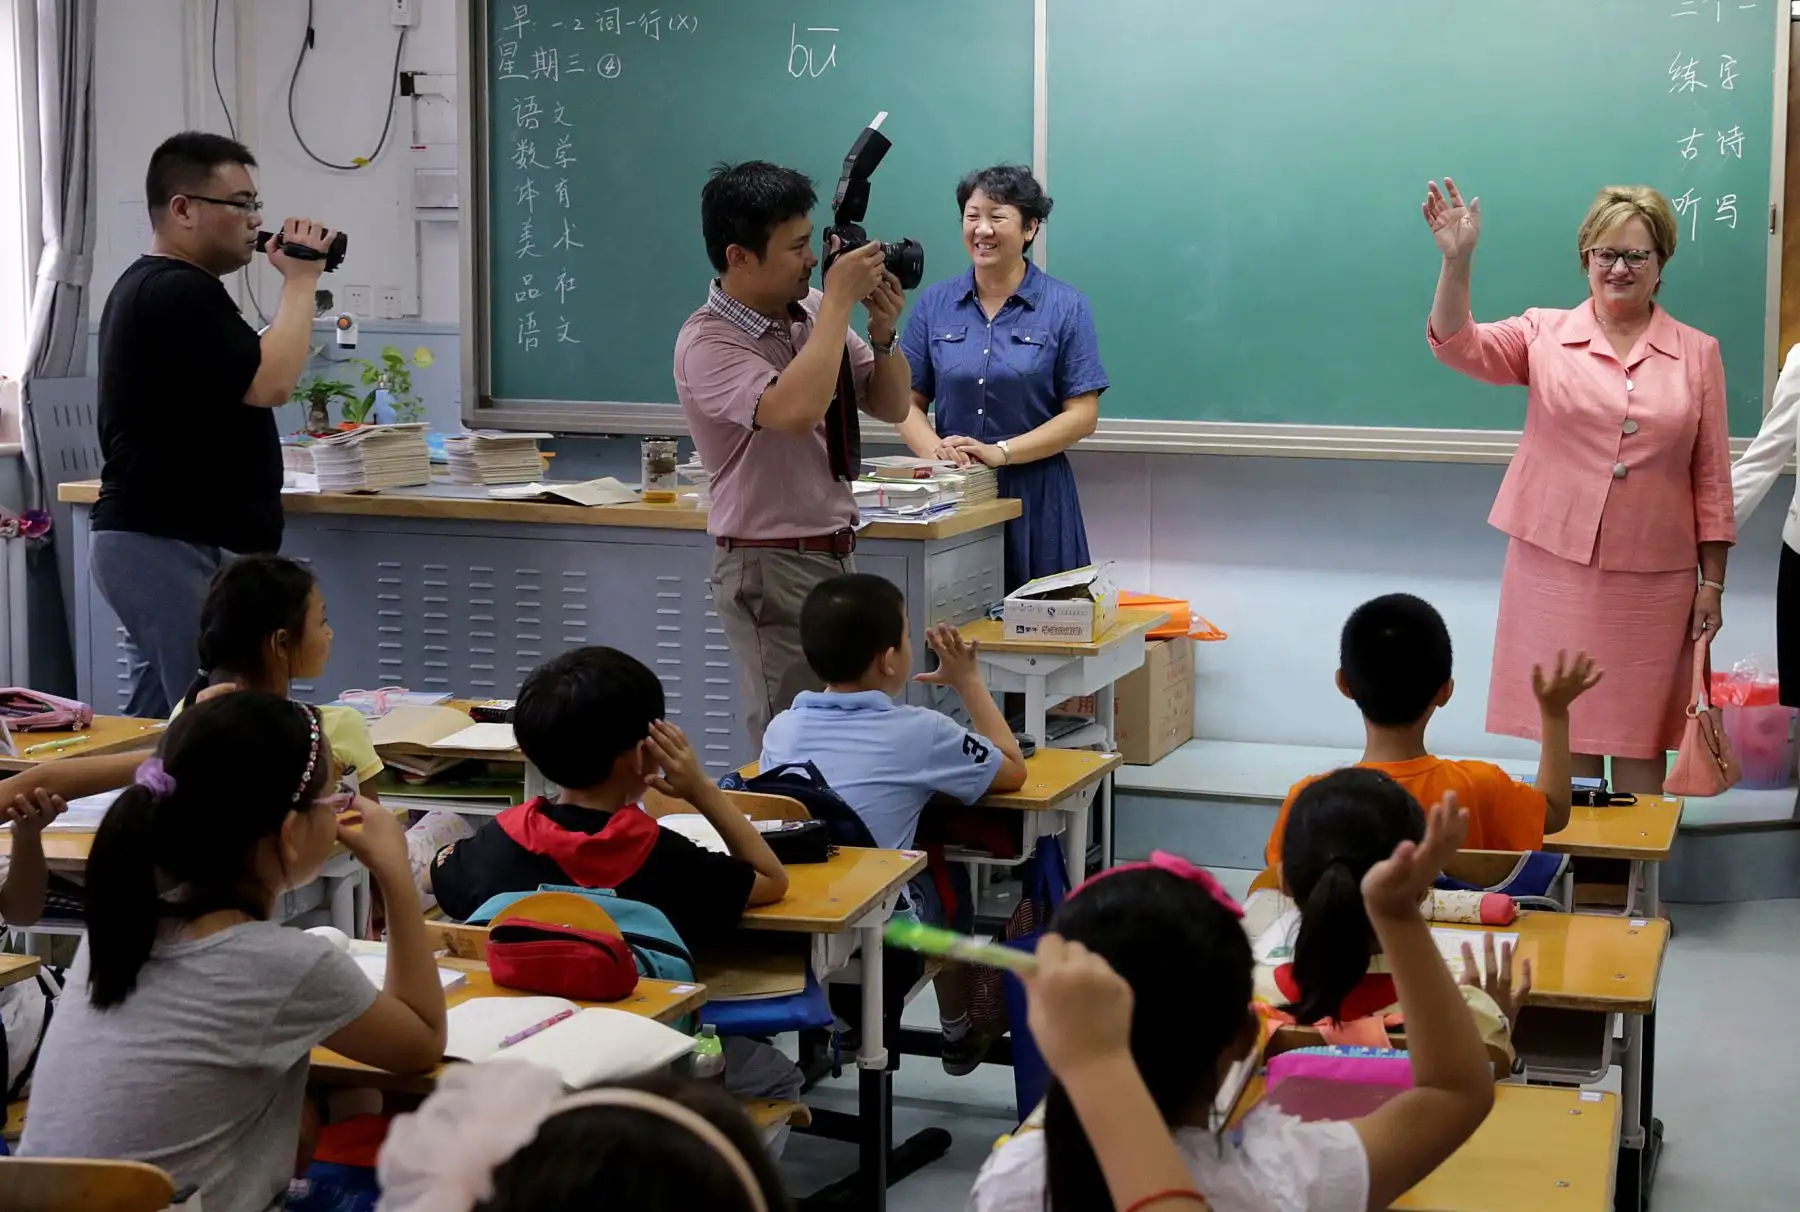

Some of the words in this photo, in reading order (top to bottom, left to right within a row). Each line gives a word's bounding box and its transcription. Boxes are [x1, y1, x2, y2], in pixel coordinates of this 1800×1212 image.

[1668, 51, 1740, 93] 练字
[512, 95, 574, 129] 语文
[510, 134, 577, 169] 数学
[1677, 126, 1746, 160] 古诗
[514, 176, 571, 213] 体育
[1671, 188, 1738, 241] 听写
[515, 217, 584, 259] 美术
[517, 311, 581, 351] 语文
[963, 734, 989, 763] 3
